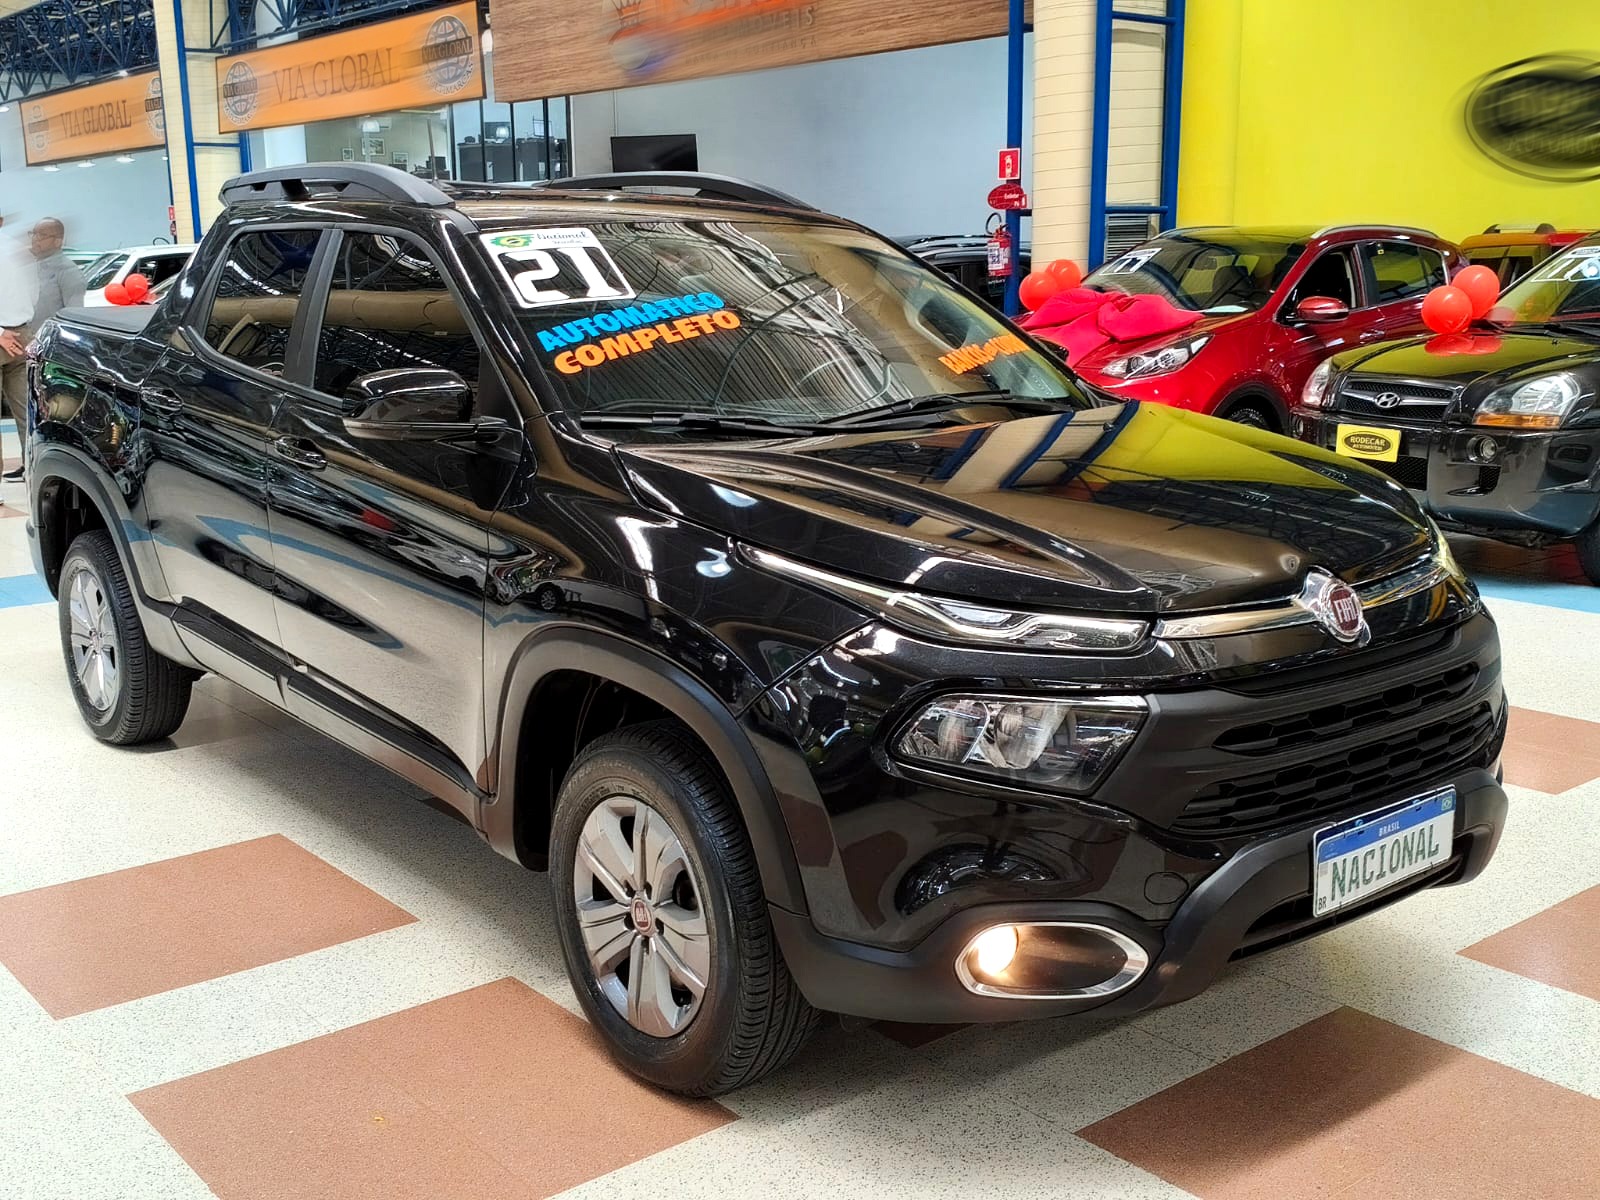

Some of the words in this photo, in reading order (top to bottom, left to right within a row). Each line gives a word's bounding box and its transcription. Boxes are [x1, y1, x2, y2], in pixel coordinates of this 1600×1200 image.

[422, 47, 438, 61] VIA
[440, 38, 473, 58] GLOBAL
[272, 65, 308, 104] VIA
[312, 48, 401, 97] GLOBAL
[60, 110, 82, 139] VIA
[82, 100, 132, 135] GLOBAL
[536, 231, 590, 241] Nacional
[504, 248, 624, 301] 21
[536, 291, 725, 352] AUTOMATICO
[554, 310, 741, 374] COMPLETO
[1350, 436, 1386, 447] RODECAR
[1379, 820, 1401, 837] BRASIL
[1331, 824, 1440, 901] NACIONAL
[1318, 895, 1327, 910] BR
